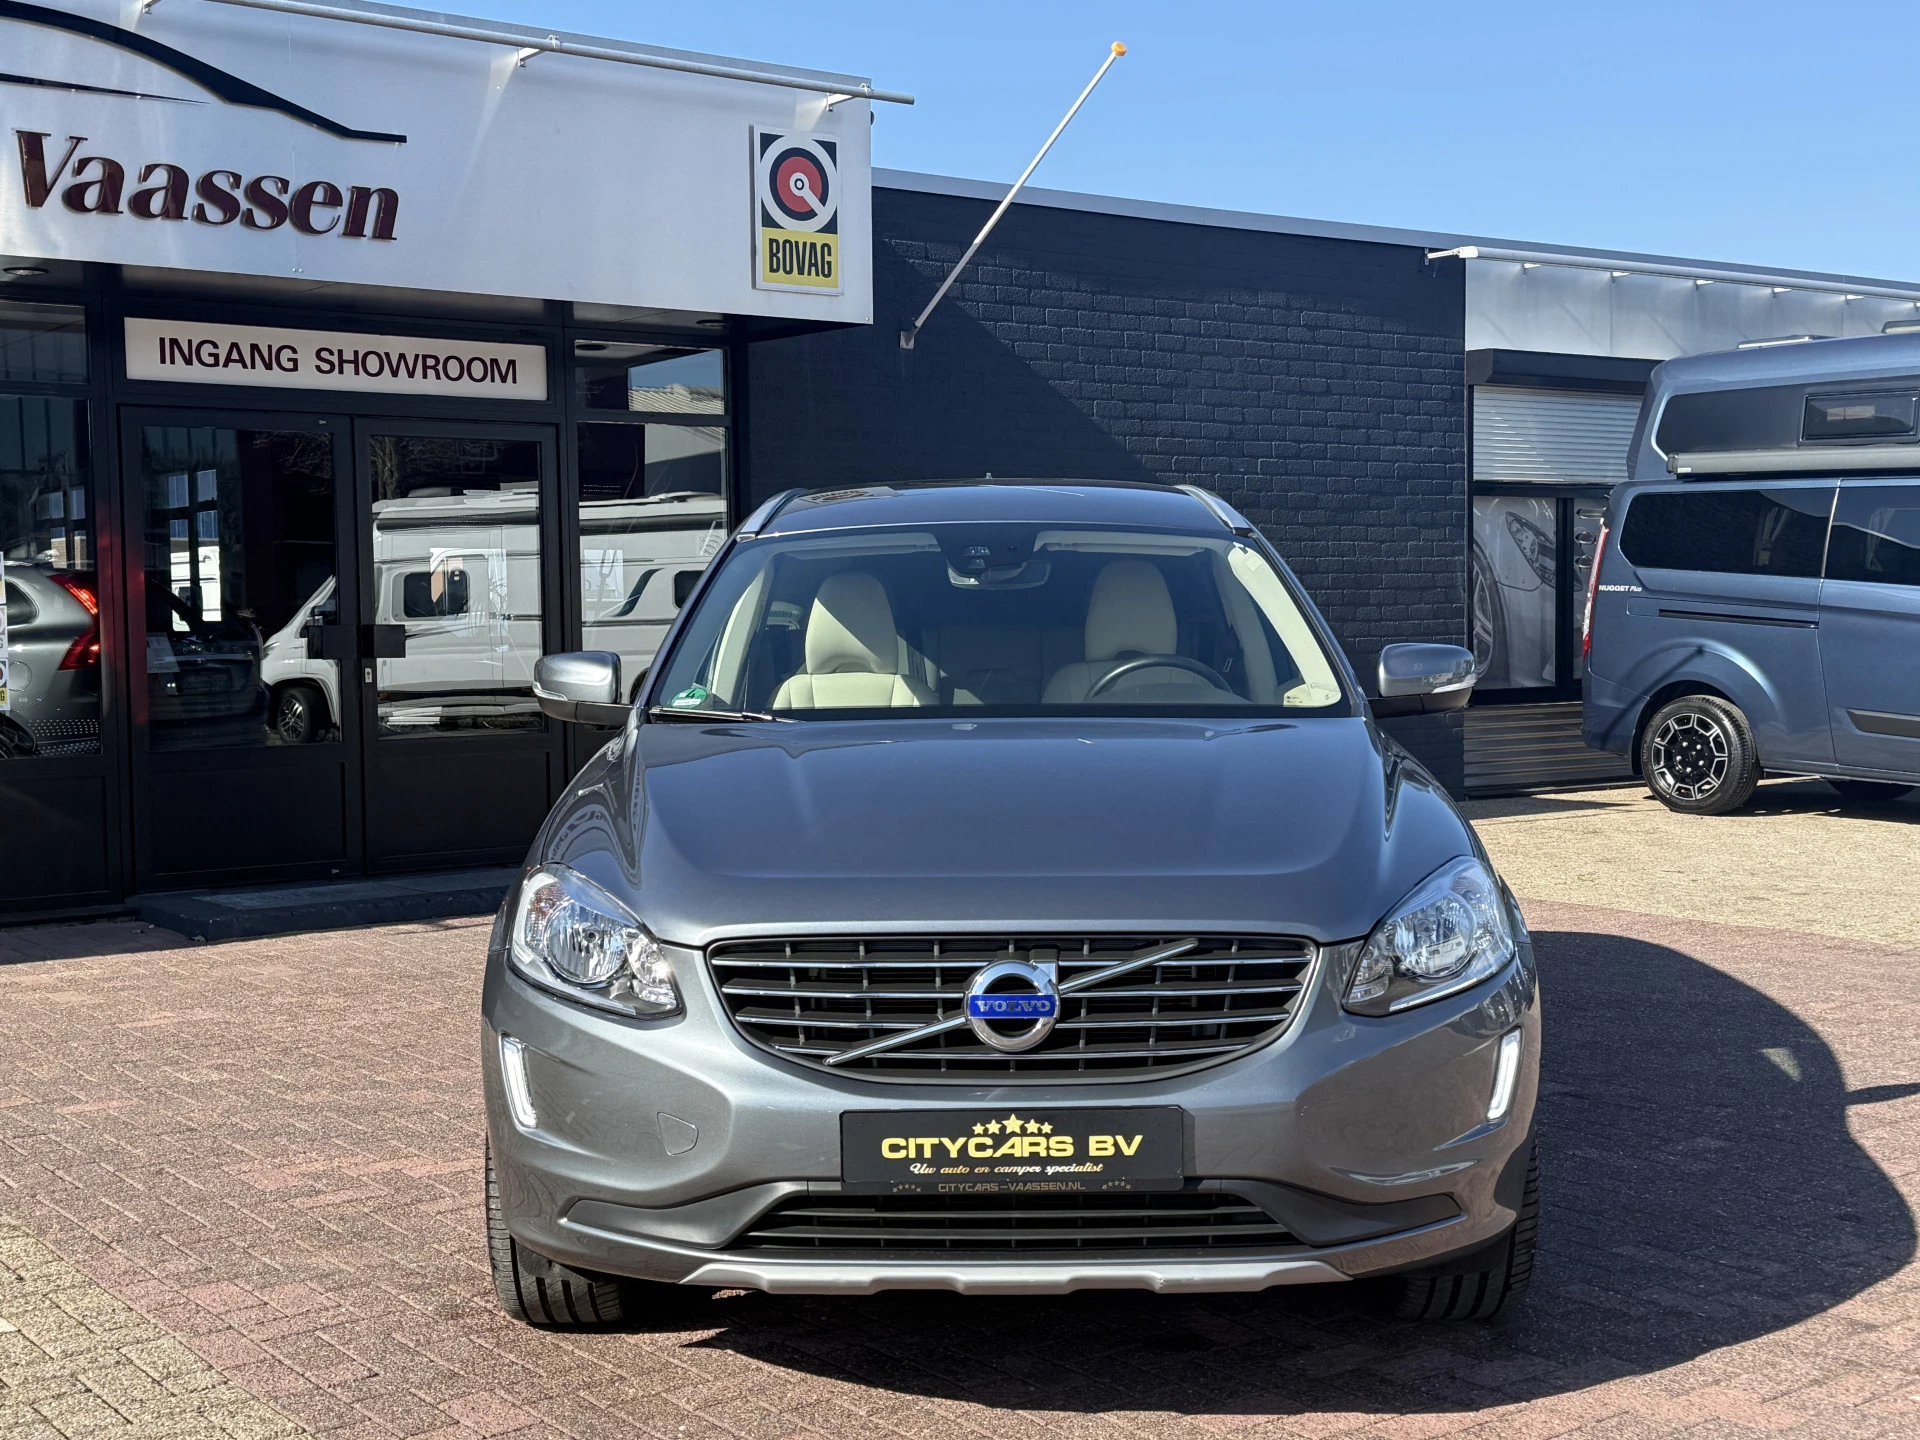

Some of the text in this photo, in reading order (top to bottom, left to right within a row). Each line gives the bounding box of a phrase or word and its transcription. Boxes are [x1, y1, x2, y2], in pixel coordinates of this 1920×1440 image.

[16, 129, 400, 241] Vaassen
[768, 237, 832, 279] BOVAG
[159, 336, 517, 384] INGANG SHOWROOM
[1598, 584, 1629, 592] NUGGET
[975, 1000, 1051, 1012] VOLVO
[881, 1134, 1143, 1159] CITYCARS BV
[910, 1162, 936, 1175] Uw
[940, 1165, 970, 1174] auto
[994, 1163, 1042, 1176] camper
[1044, 1162, 1104, 1176] specialist
[938, 1182, 1086, 1193] CITYCARS-VAASSEN.NL
